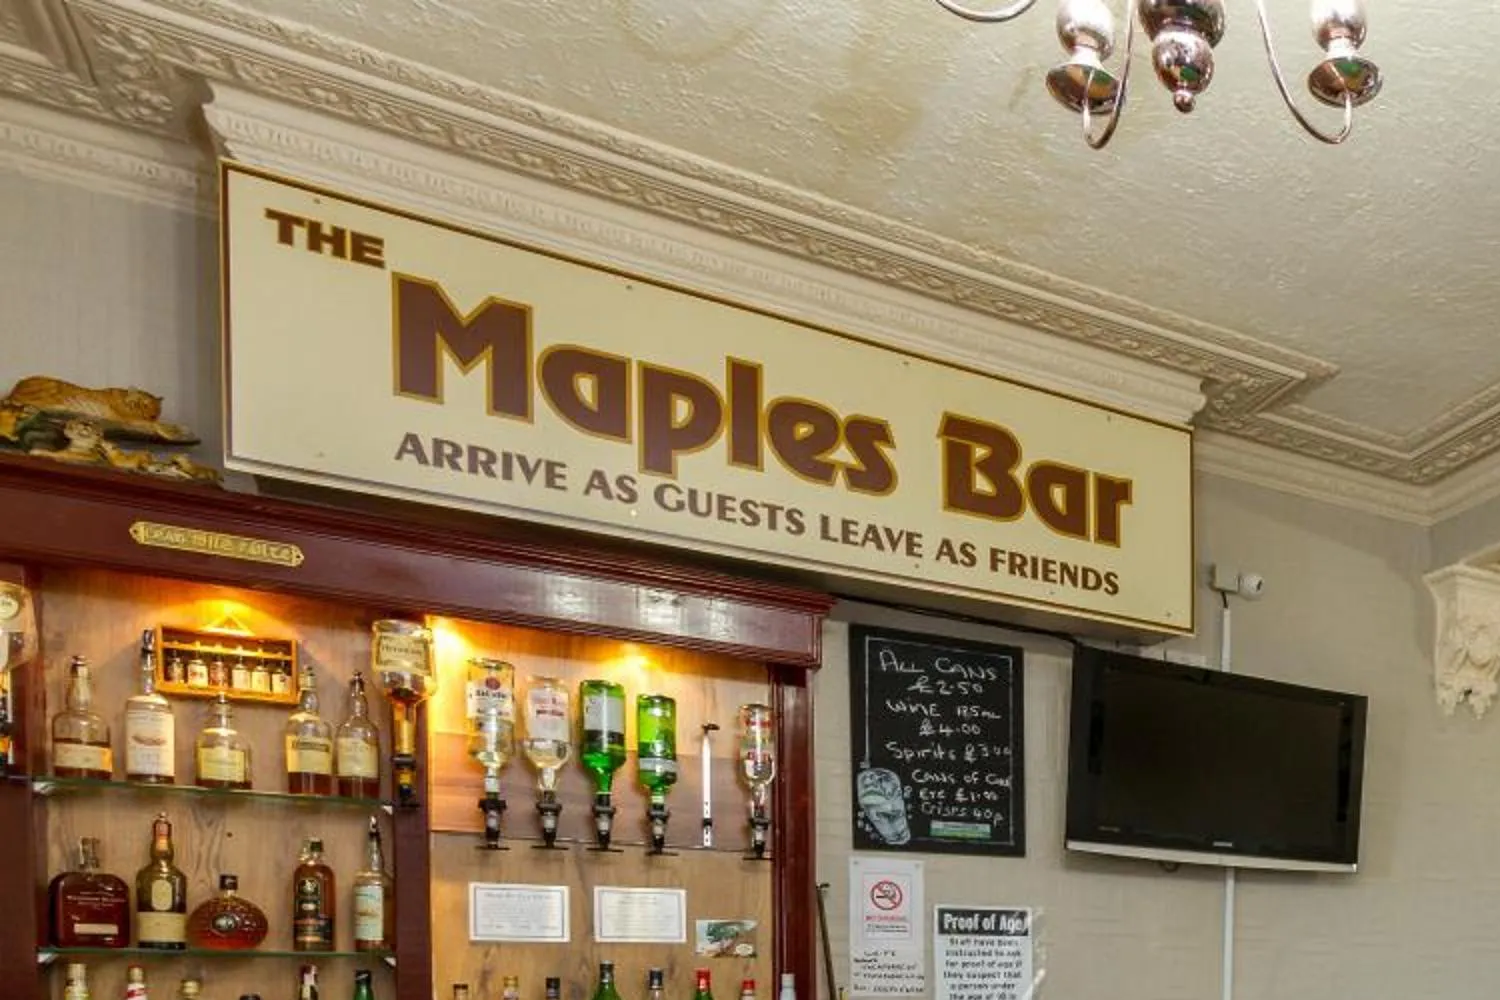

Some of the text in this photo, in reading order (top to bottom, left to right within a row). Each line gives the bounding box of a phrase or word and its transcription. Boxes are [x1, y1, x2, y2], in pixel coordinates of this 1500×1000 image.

[264, 207, 386, 269] THE
[391, 271, 1133, 549] Maples Bar
[394, 431, 1121, 597] ARRIVE AS GUESTS LEAVE AS FRIENDS
[943, 912, 980, 931] Proof
[982, 912, 997, 931] of
